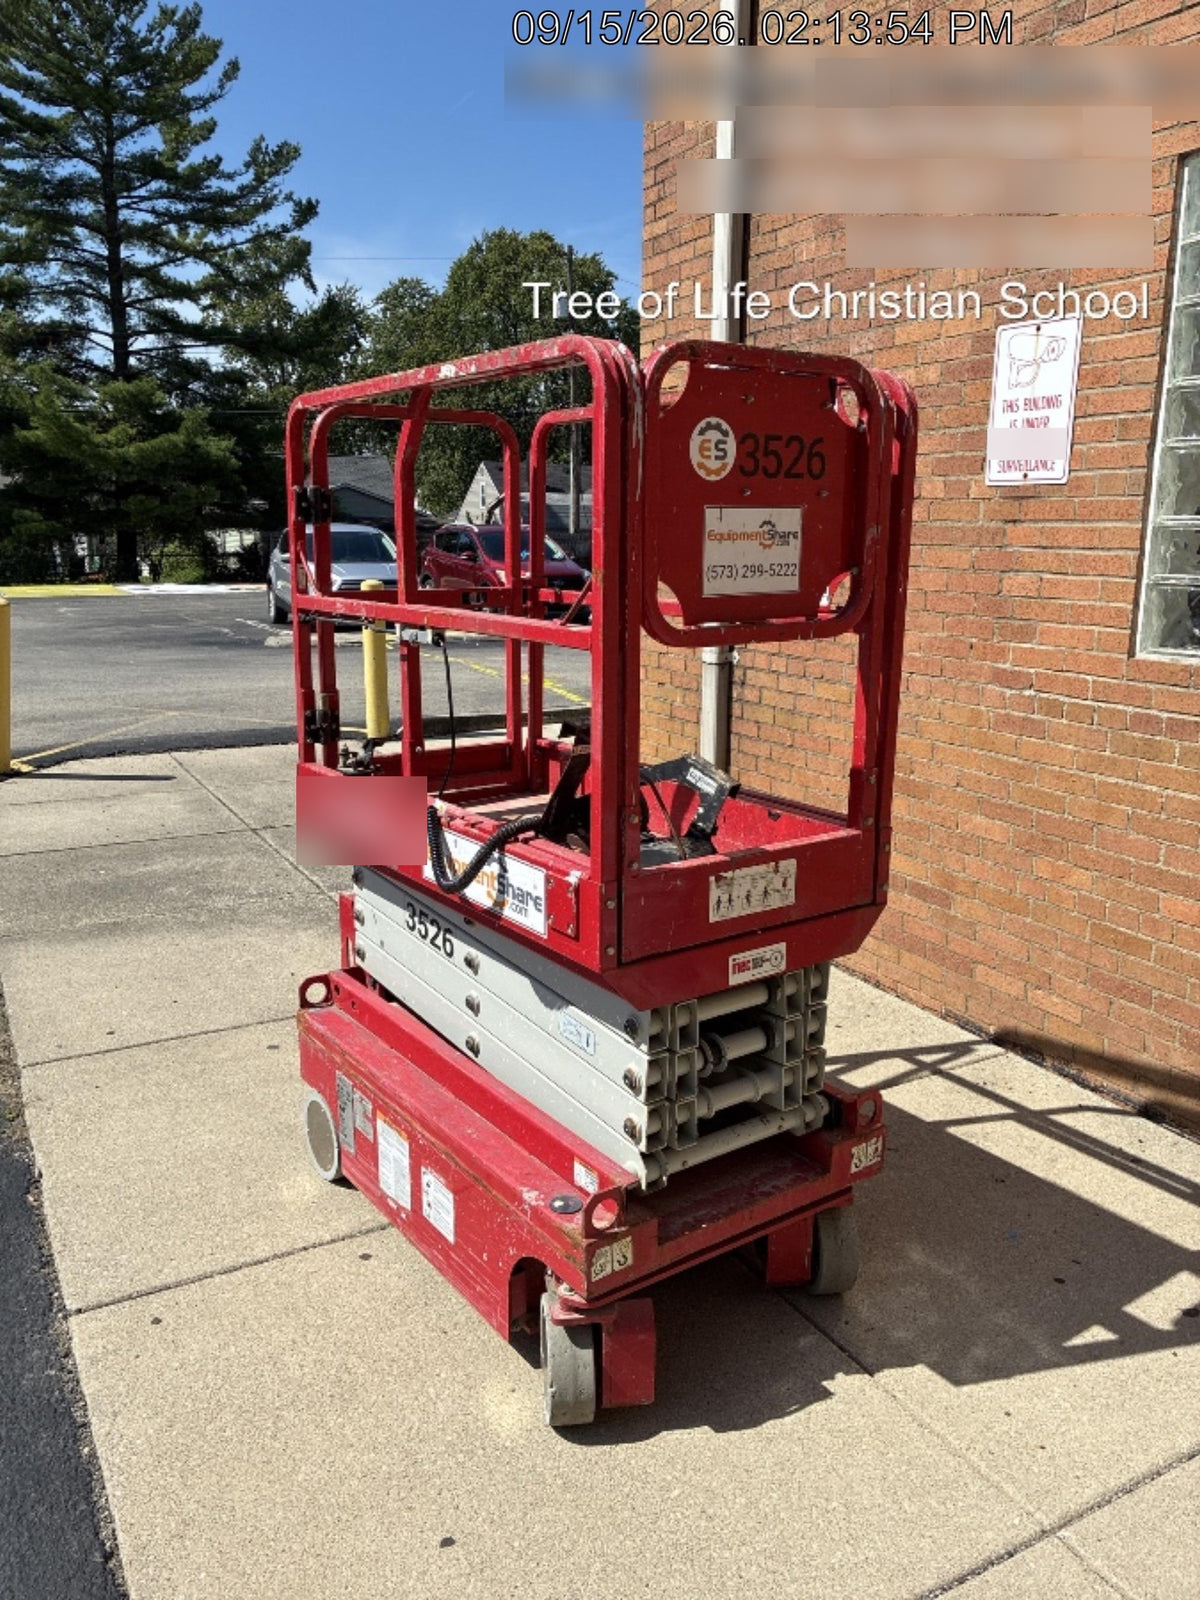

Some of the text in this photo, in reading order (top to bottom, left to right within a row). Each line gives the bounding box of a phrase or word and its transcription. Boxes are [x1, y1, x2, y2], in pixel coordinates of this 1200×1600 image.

[698, 439, 728, 461] ES
[738, 433, 826, 480] 3526
[707, 529, 799, 545] EquipmentShare
[706, 563, 798, 583] (573) 299-5222
[405, 902, 455, 959] 3526
